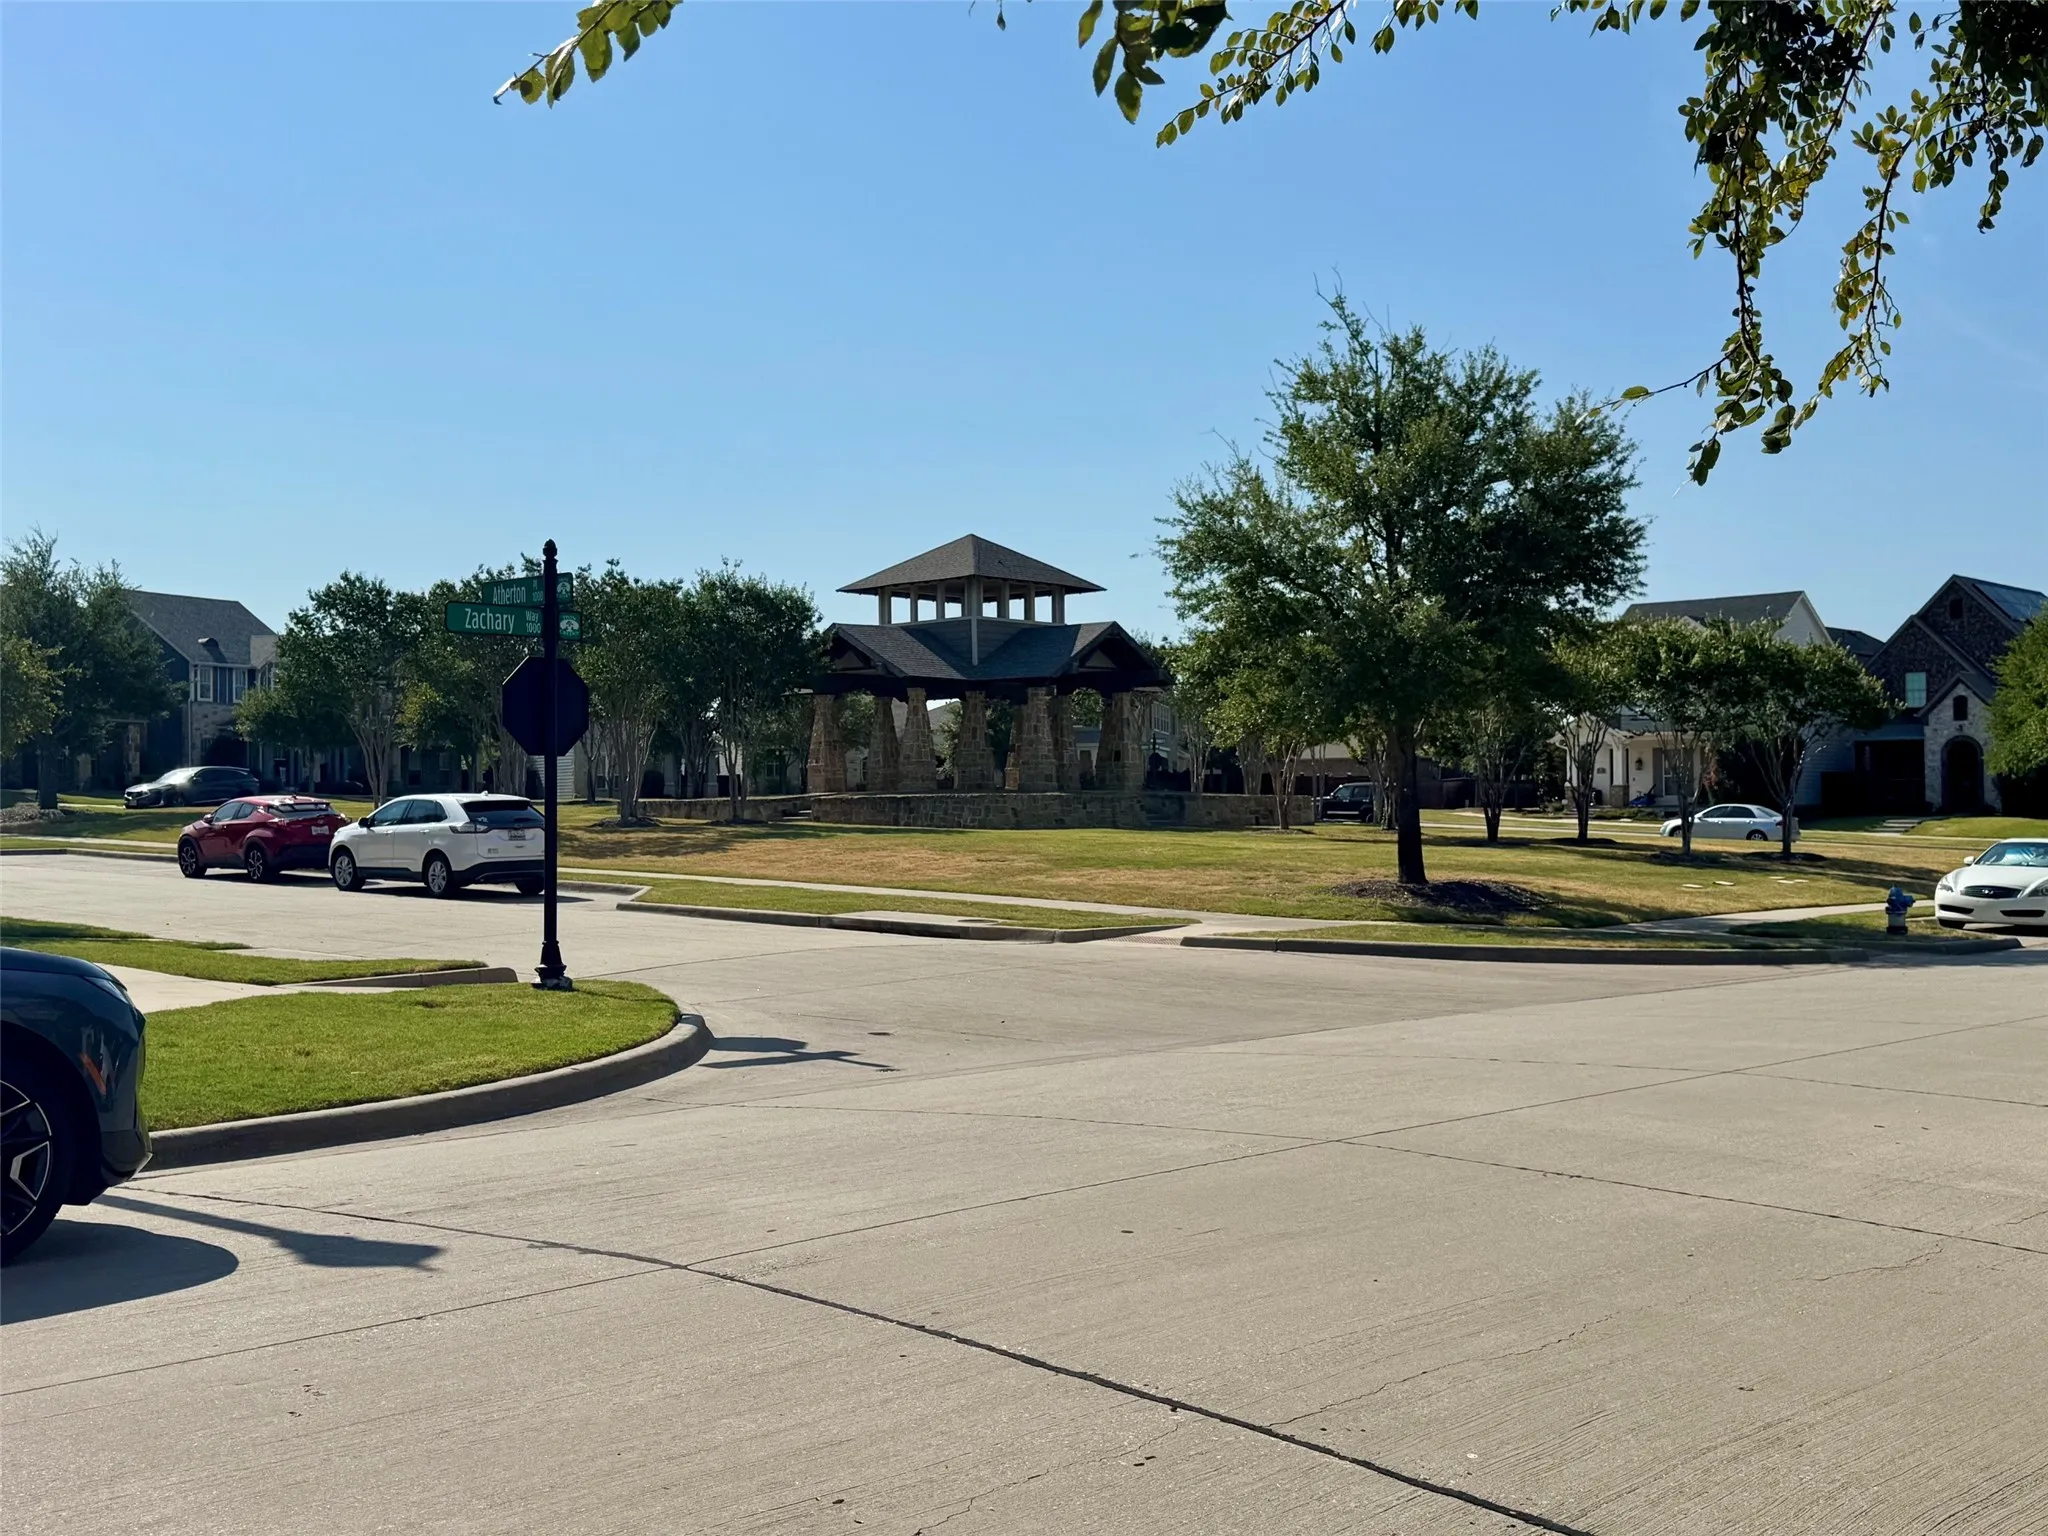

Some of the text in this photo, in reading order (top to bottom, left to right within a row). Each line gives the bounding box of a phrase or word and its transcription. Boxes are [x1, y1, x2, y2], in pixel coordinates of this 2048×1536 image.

[492, 584, 526, 605] Atherton
[465, 608, 515, 634] Zachary
[525, 610, 539, 623] Way
[525, 622, 542, 634] 1000
